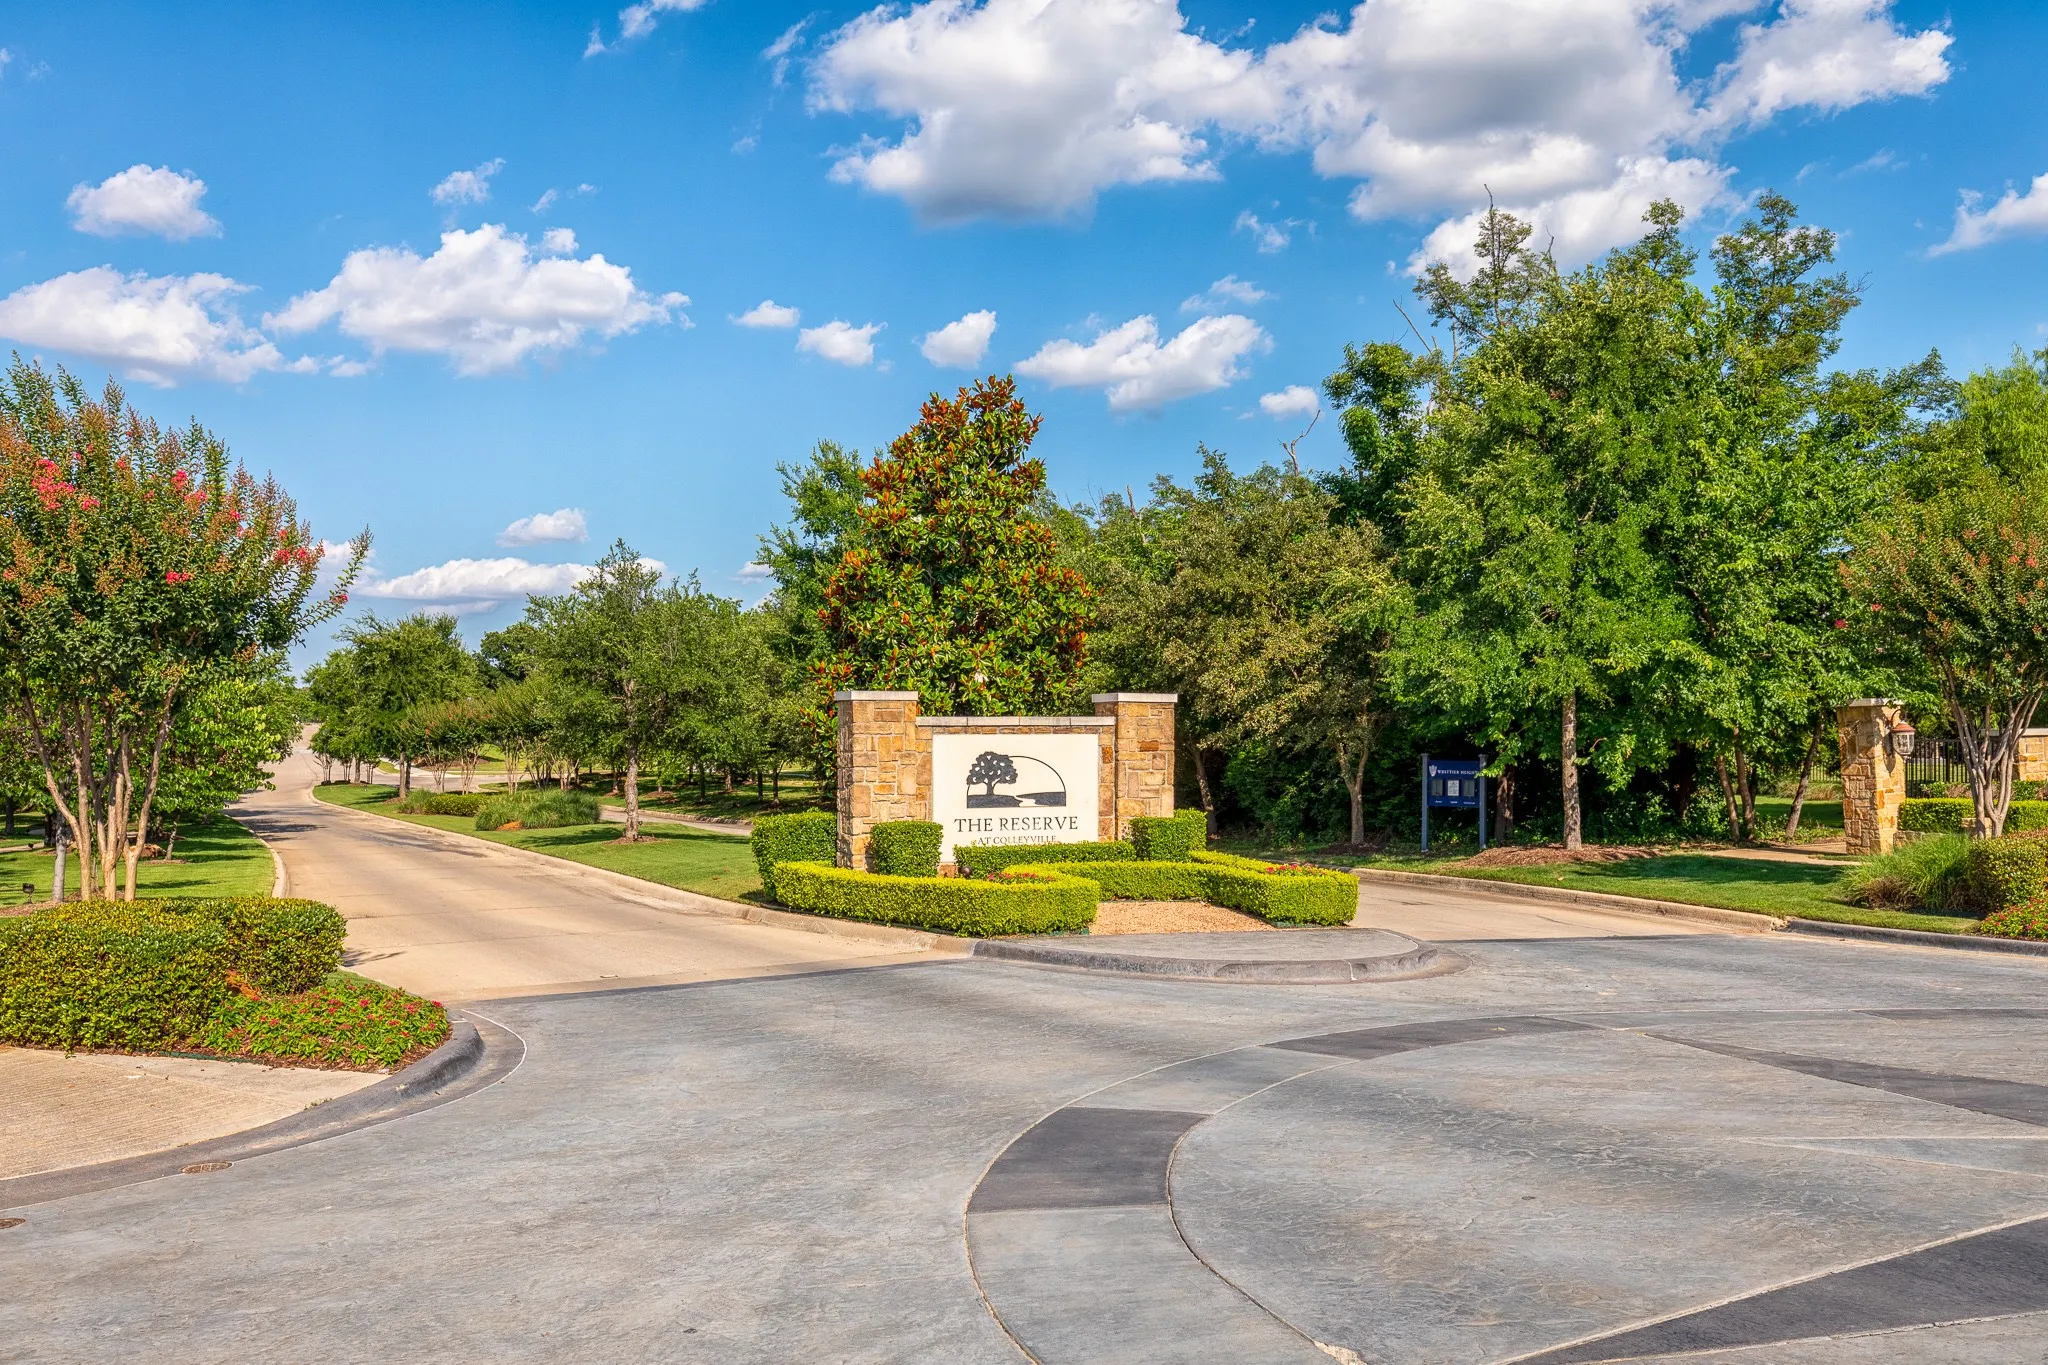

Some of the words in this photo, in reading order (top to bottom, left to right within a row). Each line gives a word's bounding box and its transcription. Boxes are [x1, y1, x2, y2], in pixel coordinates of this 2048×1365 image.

[953, 817, 994, 833] THE
[999, 816, 1079, 832] RESERVE
[977, 836, 992, 845] AT
[993, 835, 1057, 845] COLLEYVILLE
